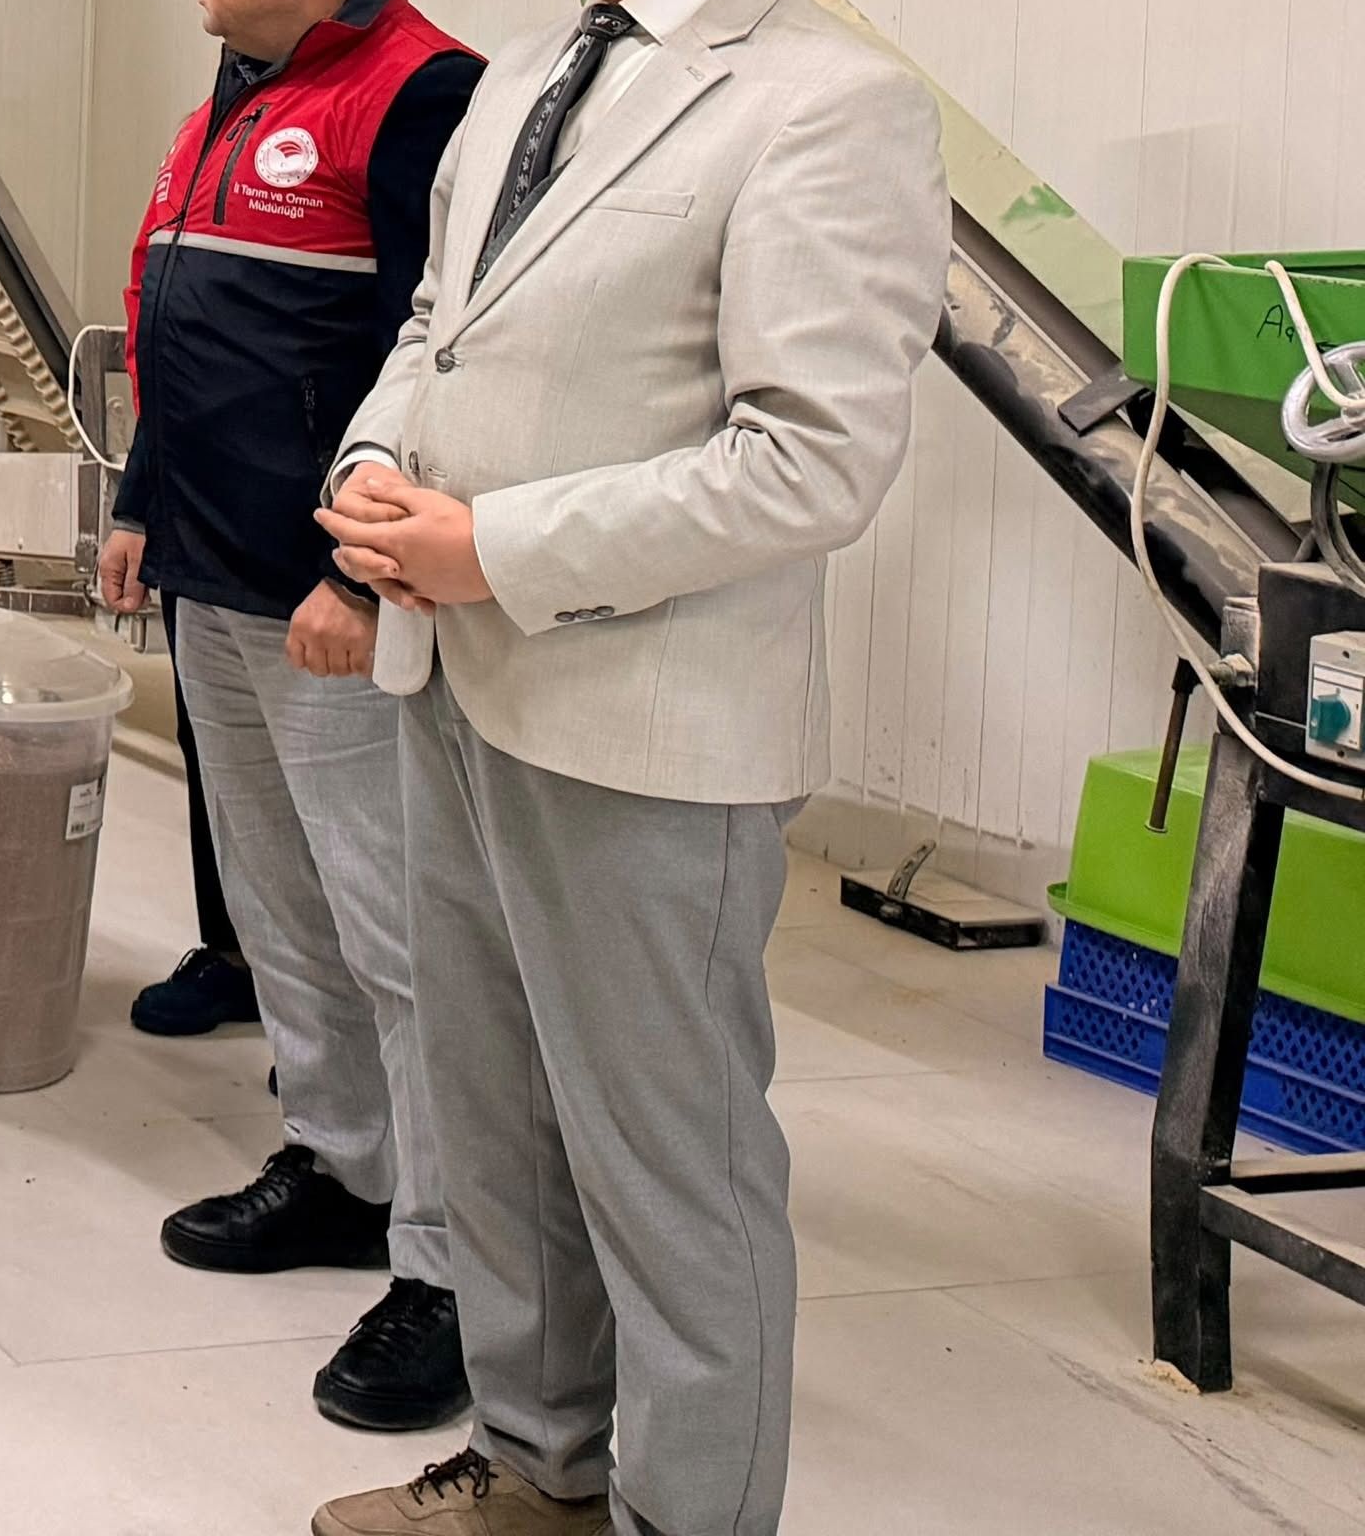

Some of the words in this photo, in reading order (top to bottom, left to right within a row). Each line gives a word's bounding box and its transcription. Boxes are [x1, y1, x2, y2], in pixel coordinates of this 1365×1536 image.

[270, 191, 283, 202] ve
[286, 193, 324, 208] Orman
[248, 199, 304, 219] Müdürlüğü
